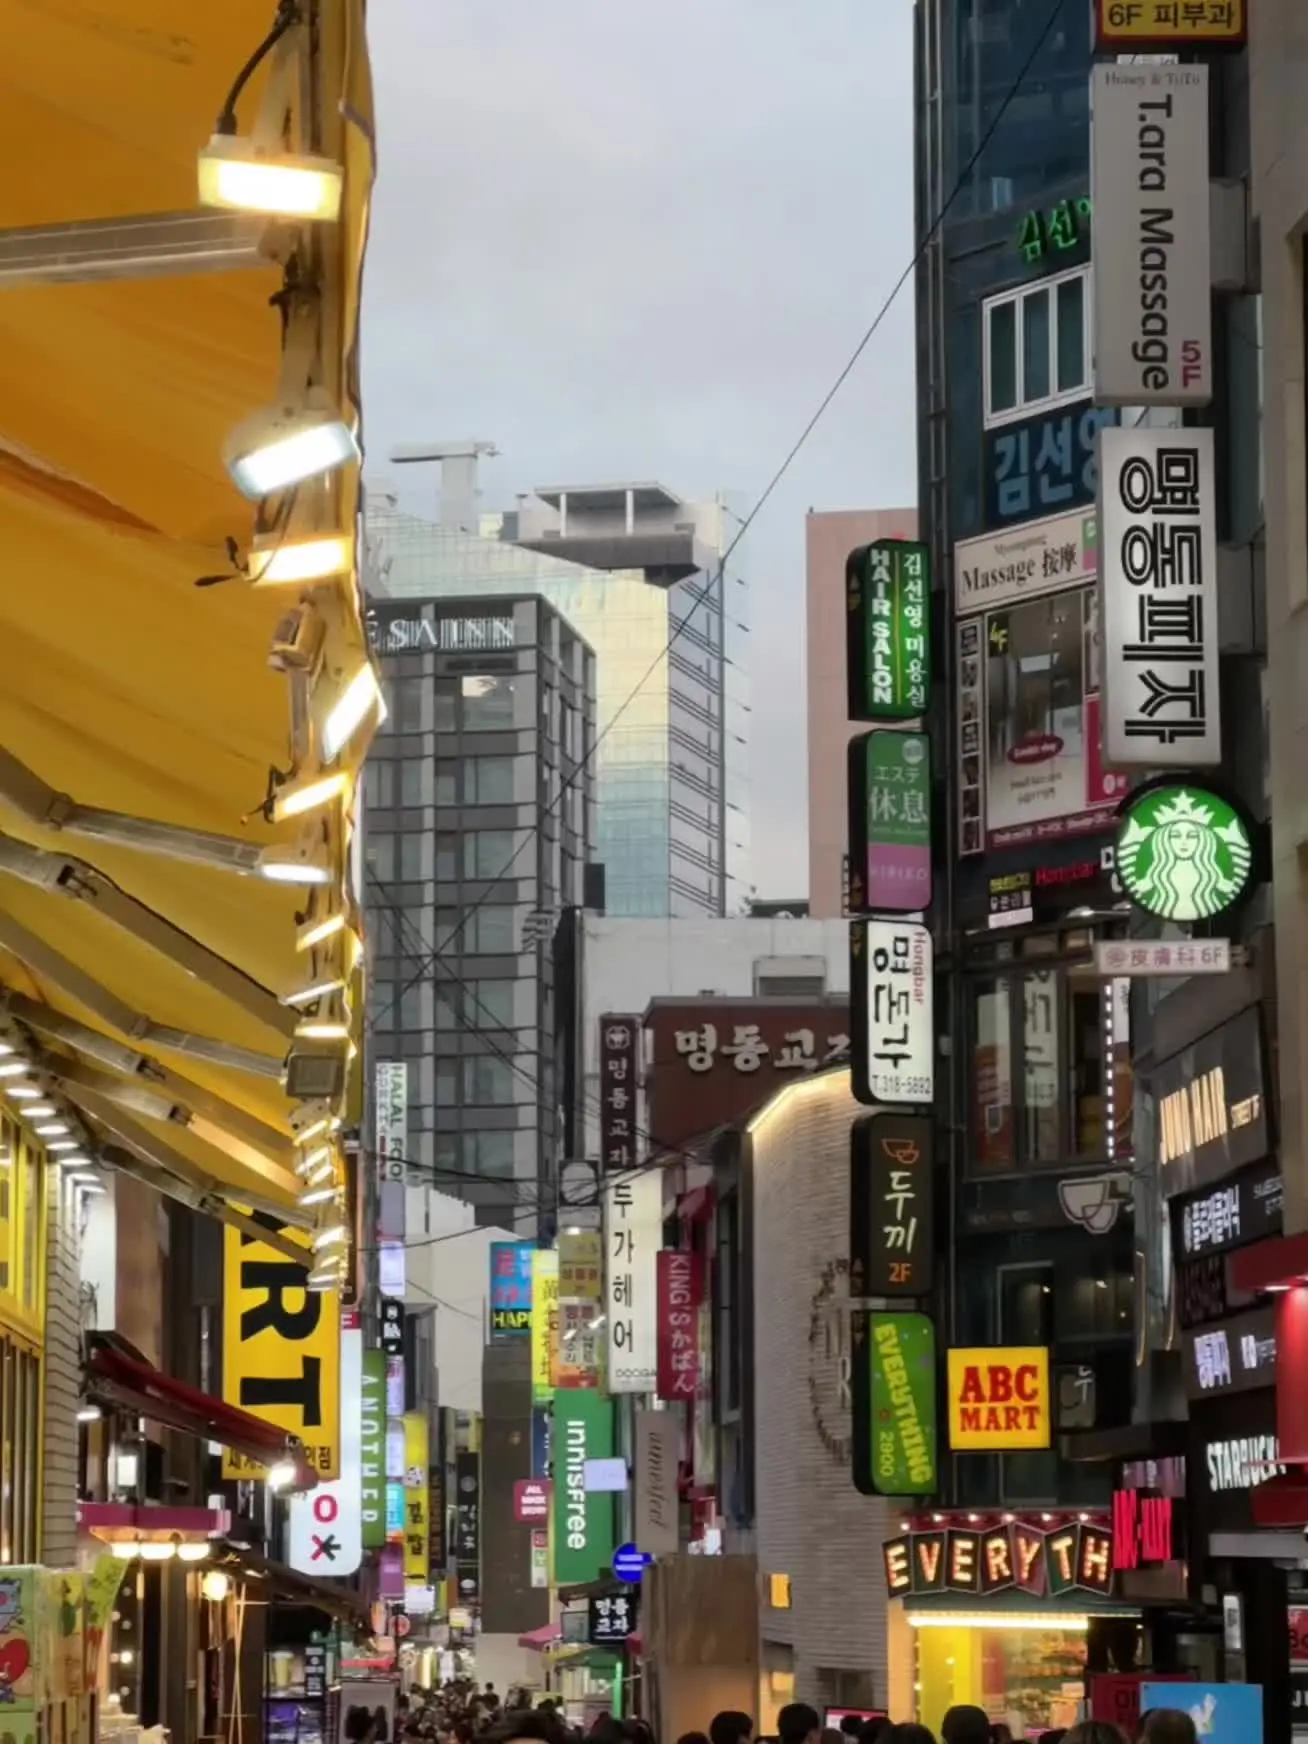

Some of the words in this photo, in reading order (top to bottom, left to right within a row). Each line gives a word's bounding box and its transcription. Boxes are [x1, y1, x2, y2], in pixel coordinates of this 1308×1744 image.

[1108, 4, 1143, 27] 6F
[1153, 3, 1235, 28] 피부과
[1138, 94, 1173, 191] T.ara
[1132, 208, 1174, 390] Massage
[1182, 340, 1201, 389] 5F
[870, 548, 892, 616] HAIR
[904, 553, 923, 628] 김선영
[962, 559, 1036, 592] Massage
[1119, 447, 1206, 743] 명동피자
[871, 621, 893, 704] SALON
[871, 785, 928, 823] 休息
[882, 1171, 917, 1254] 두끼
[612, 1183, 635, 1353] 두가헤어
[888, 1262, 912, 1283] 2F
[874, 1323, 933, 1484] EVERYTHING
[959, 1364, 1040, 1404] ABC
[960, 1406, 1041, 1433] MART
